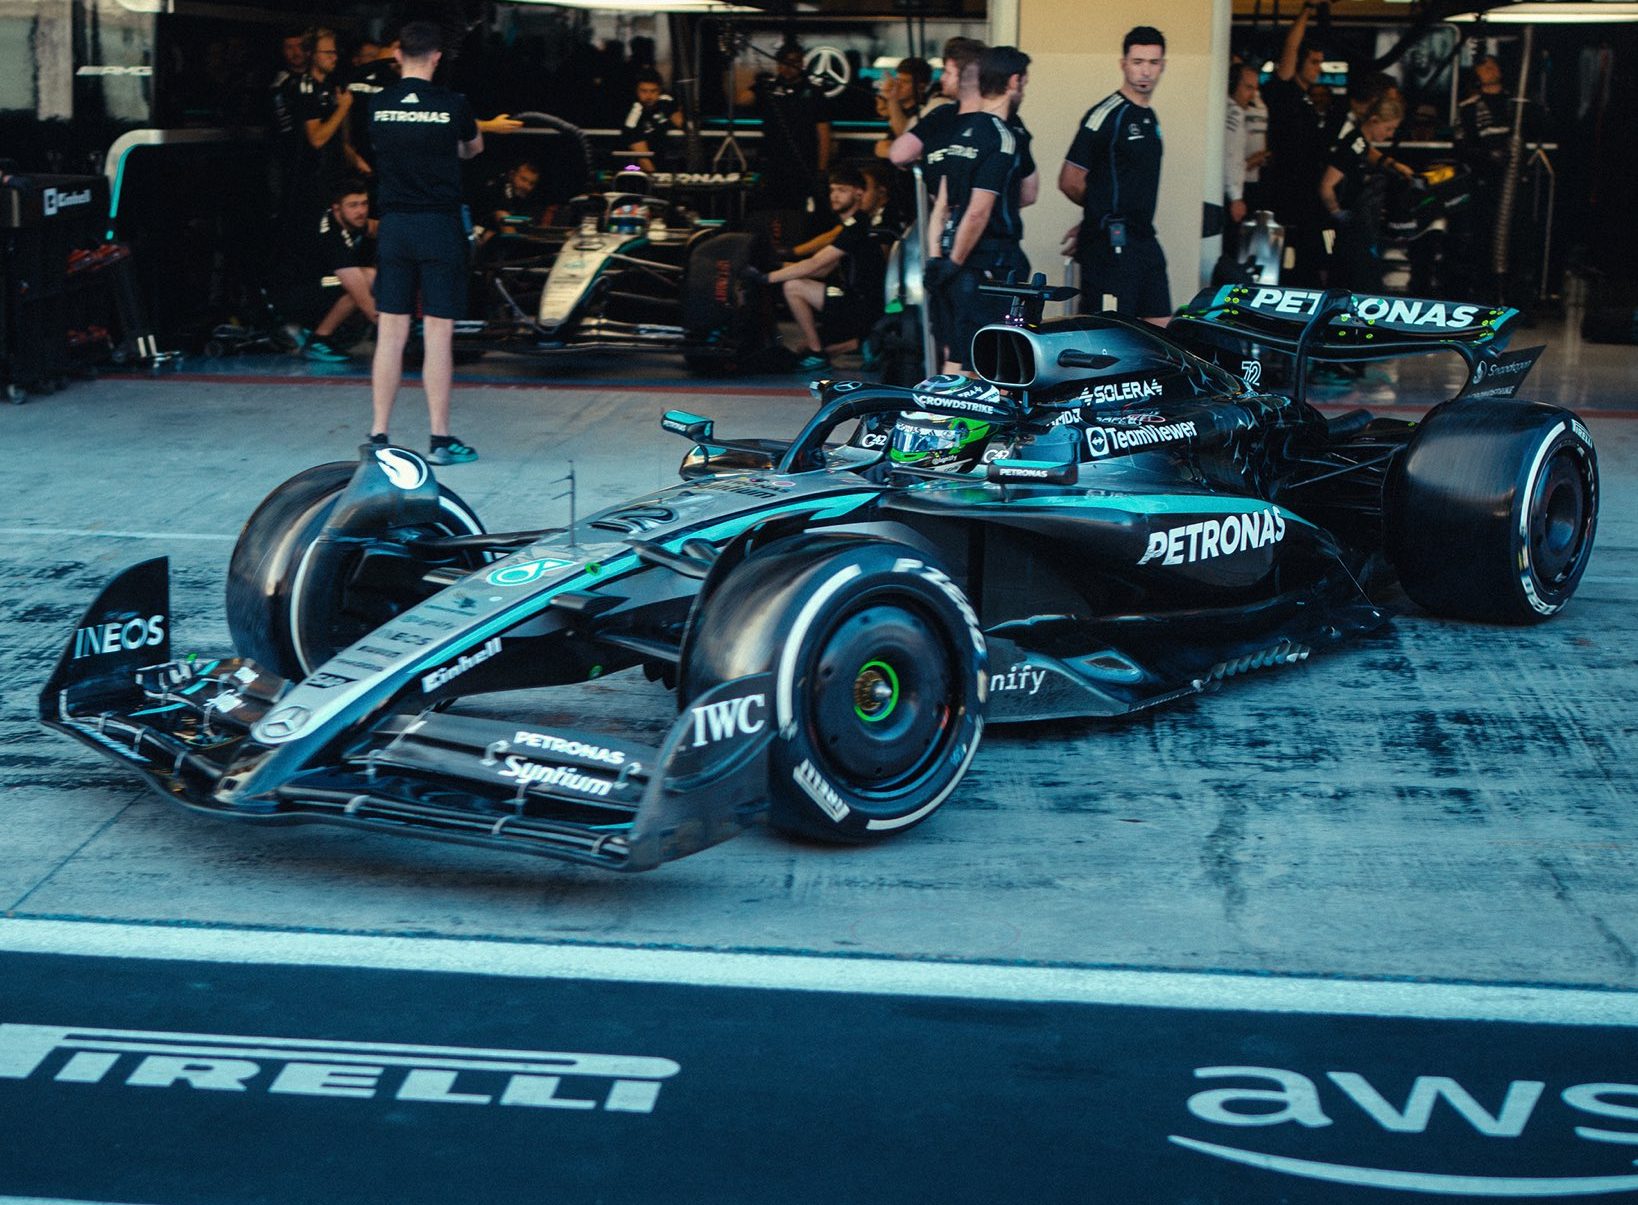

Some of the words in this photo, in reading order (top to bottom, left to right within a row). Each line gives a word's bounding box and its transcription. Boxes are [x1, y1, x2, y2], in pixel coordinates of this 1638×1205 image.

[373, 110, 451, 124] PETRONAS
[1250, 288, 1479, 329] PETONAS
[918, 395, 995, 415] CROWDSTRIKE
[1093, 379, 1155, 405] SOLERA
[861, 433, 888, 448] G42
[1105, 420, 1199, 451] TeamViewer
[983, 449, 1011, 464] G42
[999, 468, 1049, 478] PETRONAS
[1136, 505, 1287, 566] PETRONAS
[74, 614, 165, 660] INEOS
[421, 636, 504, 694] Einhell
[691, 693, 765, 748] IWC
[513, 731, 626, 765] PETRONAS
[497, 755, 613, 796] Syntium
[0, 1023, 681, 1113] PIRELLI
[1187, 1065, 1638, 1145] aws
